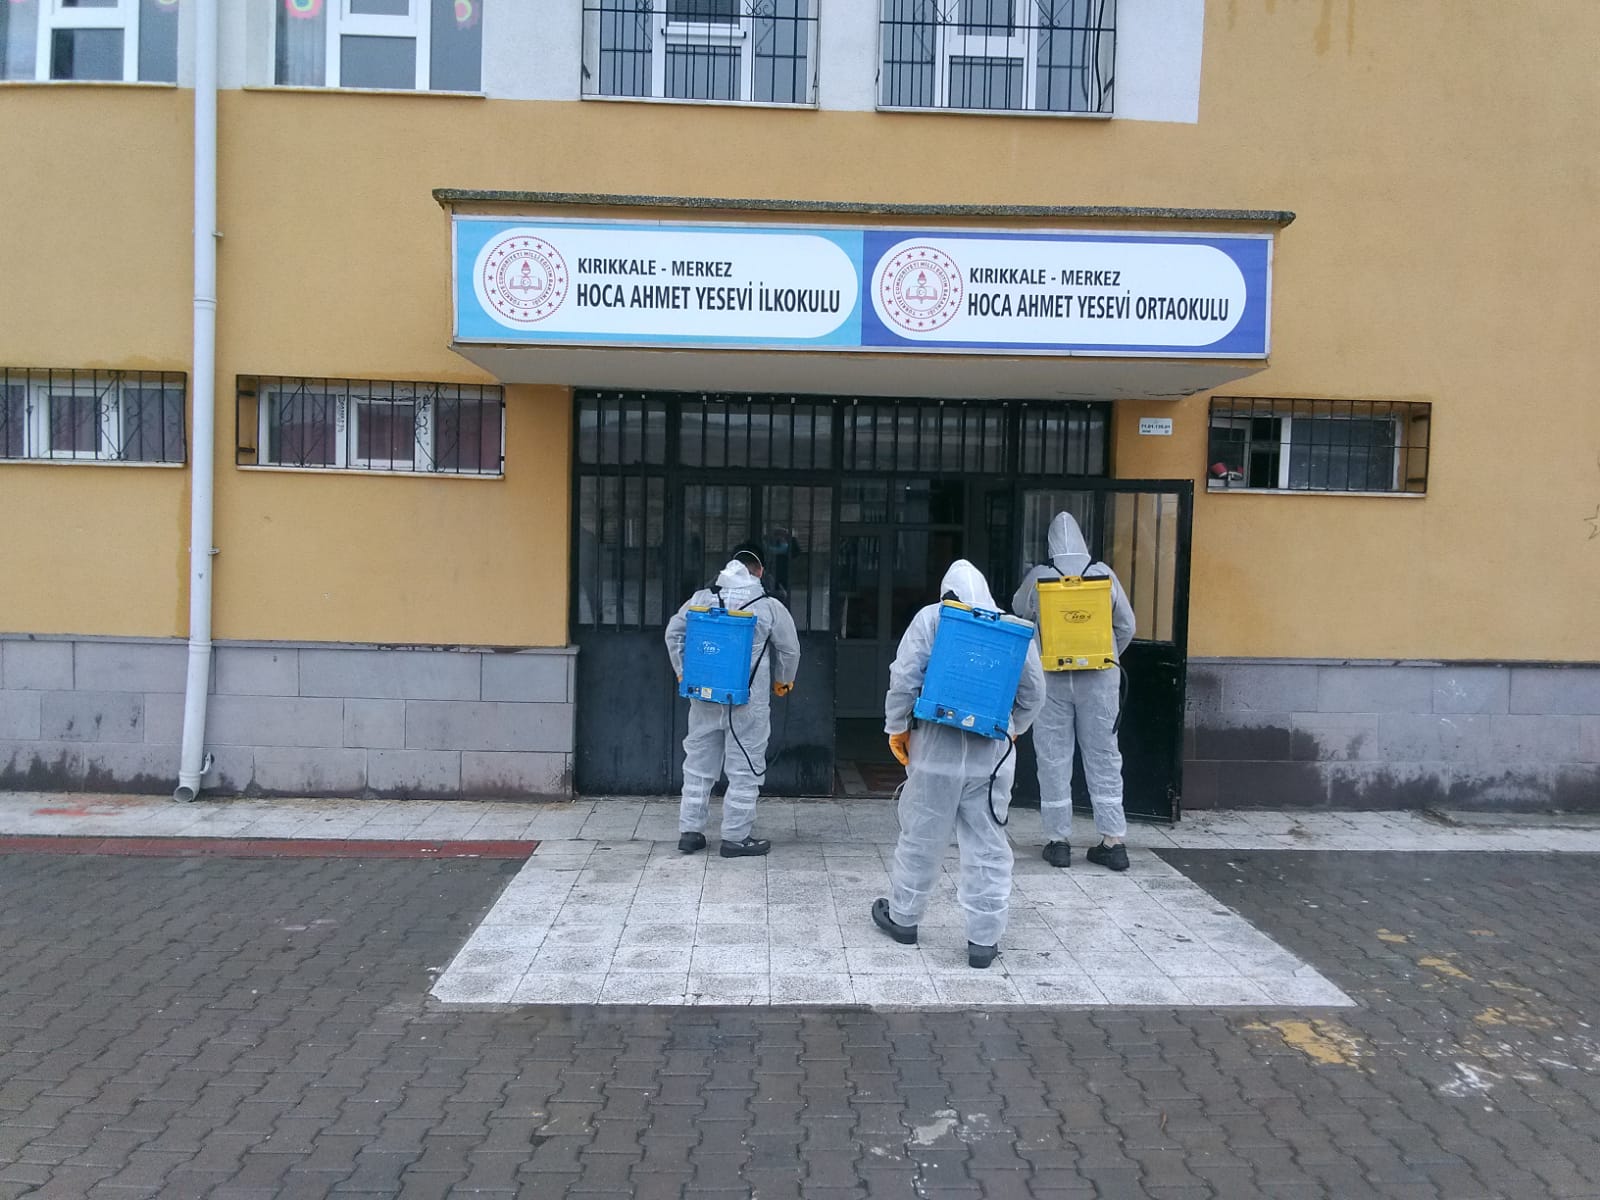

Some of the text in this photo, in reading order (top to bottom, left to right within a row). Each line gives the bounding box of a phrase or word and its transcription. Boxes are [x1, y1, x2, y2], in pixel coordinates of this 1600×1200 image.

[578, 257, 657, 276] KIRIKKALE
[672, 260, 732, 278] MERKEZ
[969, 267, 1046, 286] KIRIKKALE
[1061, 269, 1121, 287] MERKEZ
[577, 281, 840, 314] HOCA AHMET YESEVİ İLKOKULU
[968, 289, 1229, 322] HOCA AHMET YESEVİ ORTAOKULU
